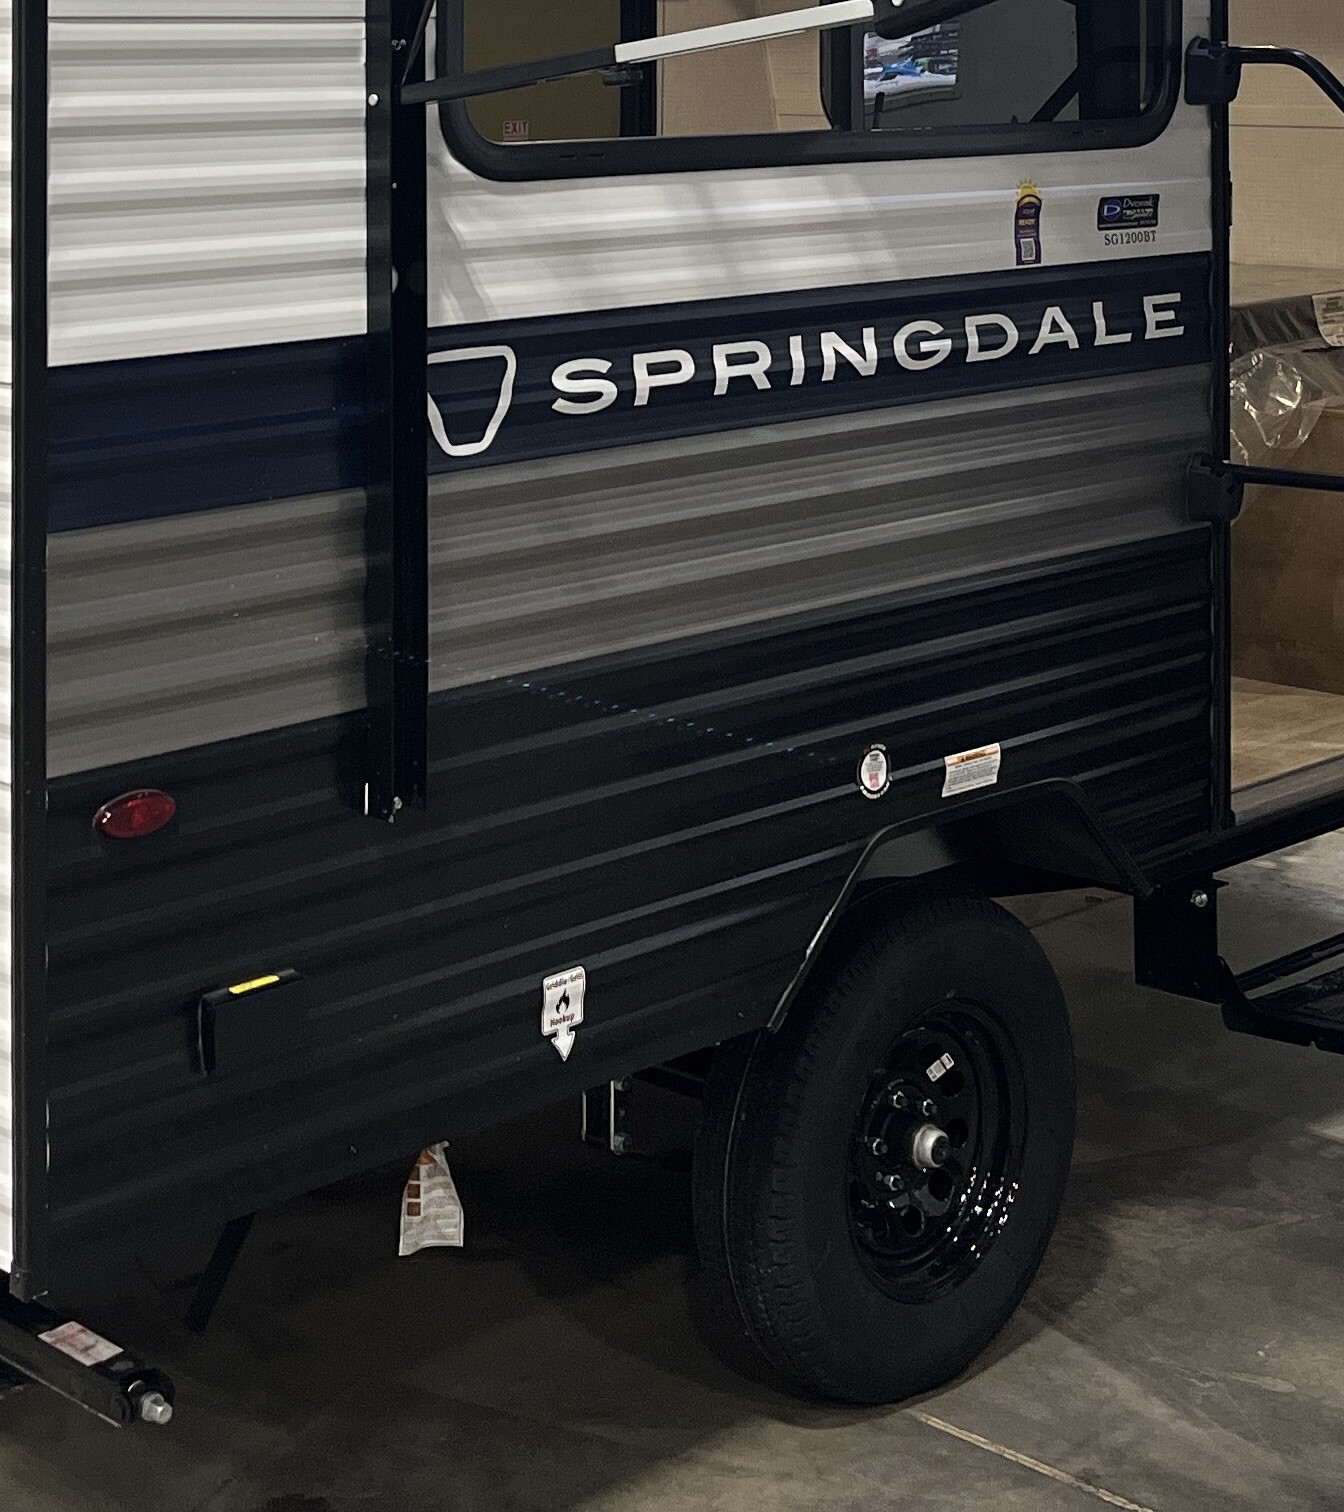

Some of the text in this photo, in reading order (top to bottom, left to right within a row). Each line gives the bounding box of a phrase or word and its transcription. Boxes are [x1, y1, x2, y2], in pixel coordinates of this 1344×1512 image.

[504, 121, 528, 135] EXIT
[1104, 230, 1156, 246] SG1200BT
[551, 292, 1185, 414] SPRINGDALE
